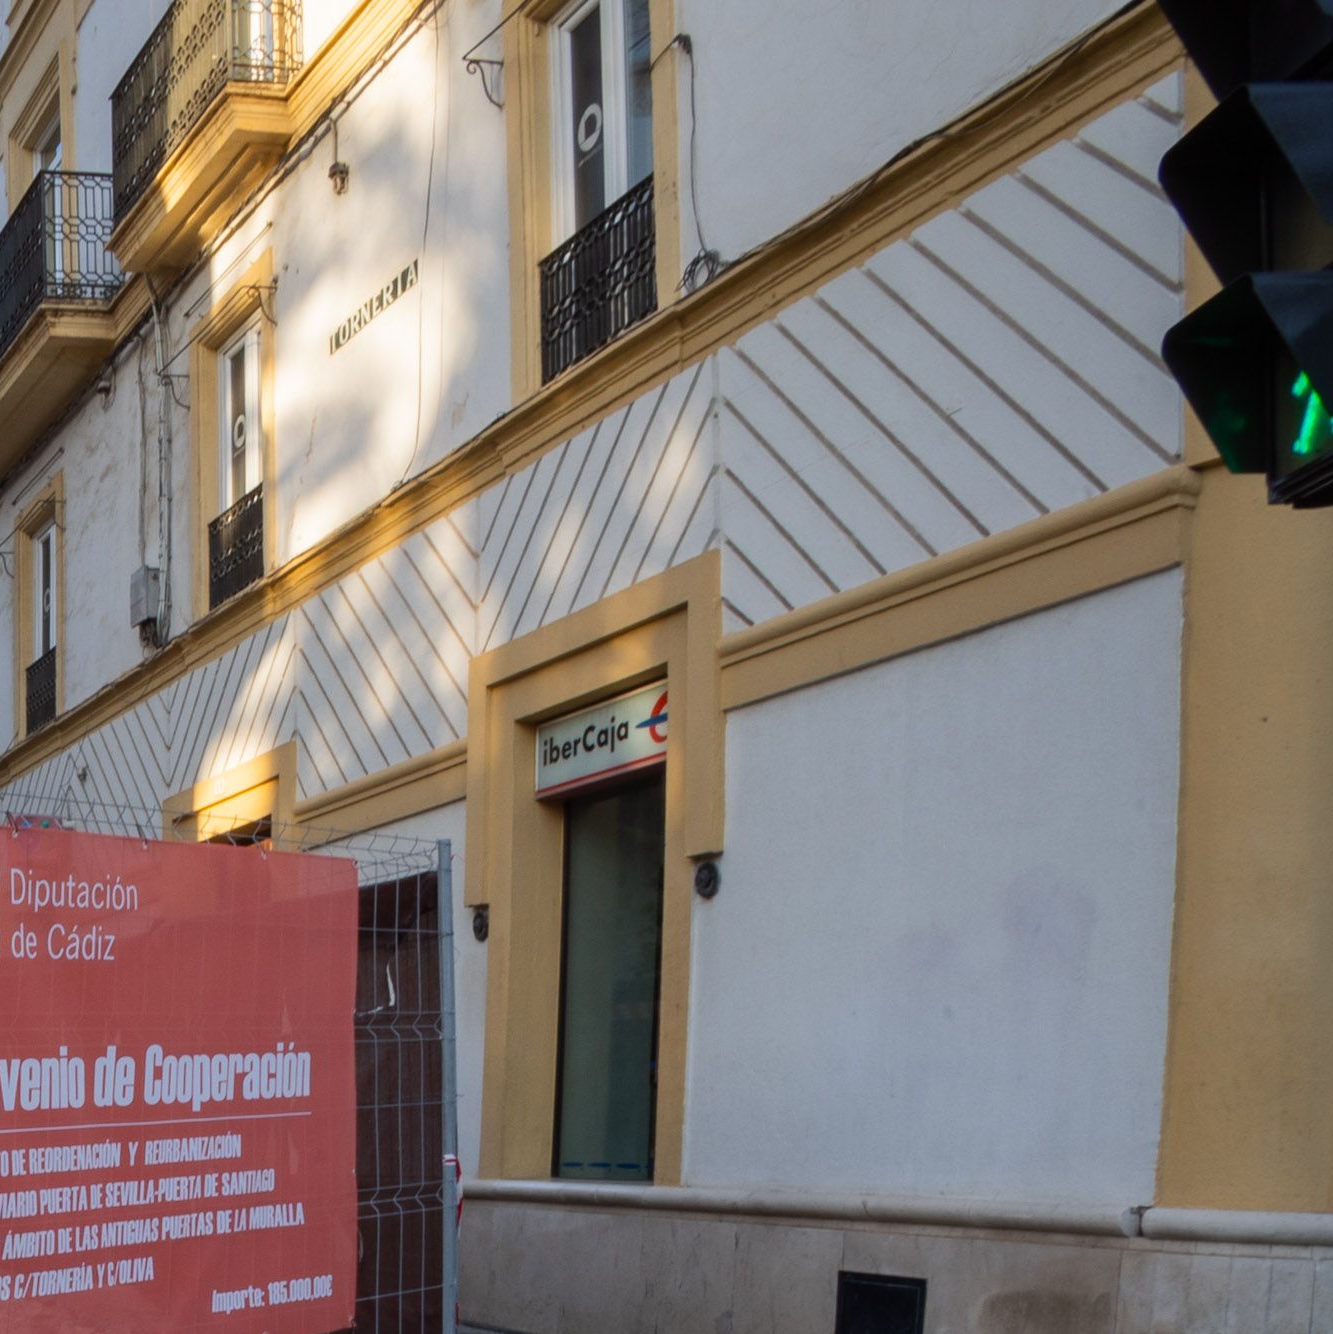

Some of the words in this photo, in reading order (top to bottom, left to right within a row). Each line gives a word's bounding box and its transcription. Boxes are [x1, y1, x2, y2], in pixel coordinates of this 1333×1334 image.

[543, 716, 629, 767] iberCaja
[10, 867, 138, 912] Diputación
[11, 923, 37, 960] de
[47, 922, 116, 960] Cádiz
[93, 1045, 136, 1107] de
[144, 1041, 311, 1112] Cooperación
[12, 1149, 26, 1176] DE
[29, 1139, 121, 1174] REORDENACIÓN
[129, 1141, 139, 1166] Y
[144, 1133, 242, 1166] REURBANIZACIÓN
[40, 1186, 88, 1215] PUERTA
[90, 1184, 103, 1209] DE
[105, 1174, 201, 1208] SEVILLA-PUERTA
[204, 1173, 219, 1197] DE
[221, 1168, 275, 1196] SANTIAGO
[2, 1230, 55, 1261] ÁMBITO
[58, 1228, 73, 1254] DE
[75, 1224, 99, 1252] LAS
[101, 1216, 159, 1247] ANTIGUAS
[161, 1211, 213, 1241] PUERTAS
[216, 1208, 231, 1234] DE
[234, 1207, 247, 1232] LA
[249, 1202, 305, 1229] MURALLA
[14, 1262, 93, 1299] C/TORNERÍA
[97, 1262, 105, 1286] Y
[107, 1256, 155, 1286] C/OLIVA
[211, 1288, 266, 1314] Importe:
[268, 1274, 333, 1306] 185.000,00€
